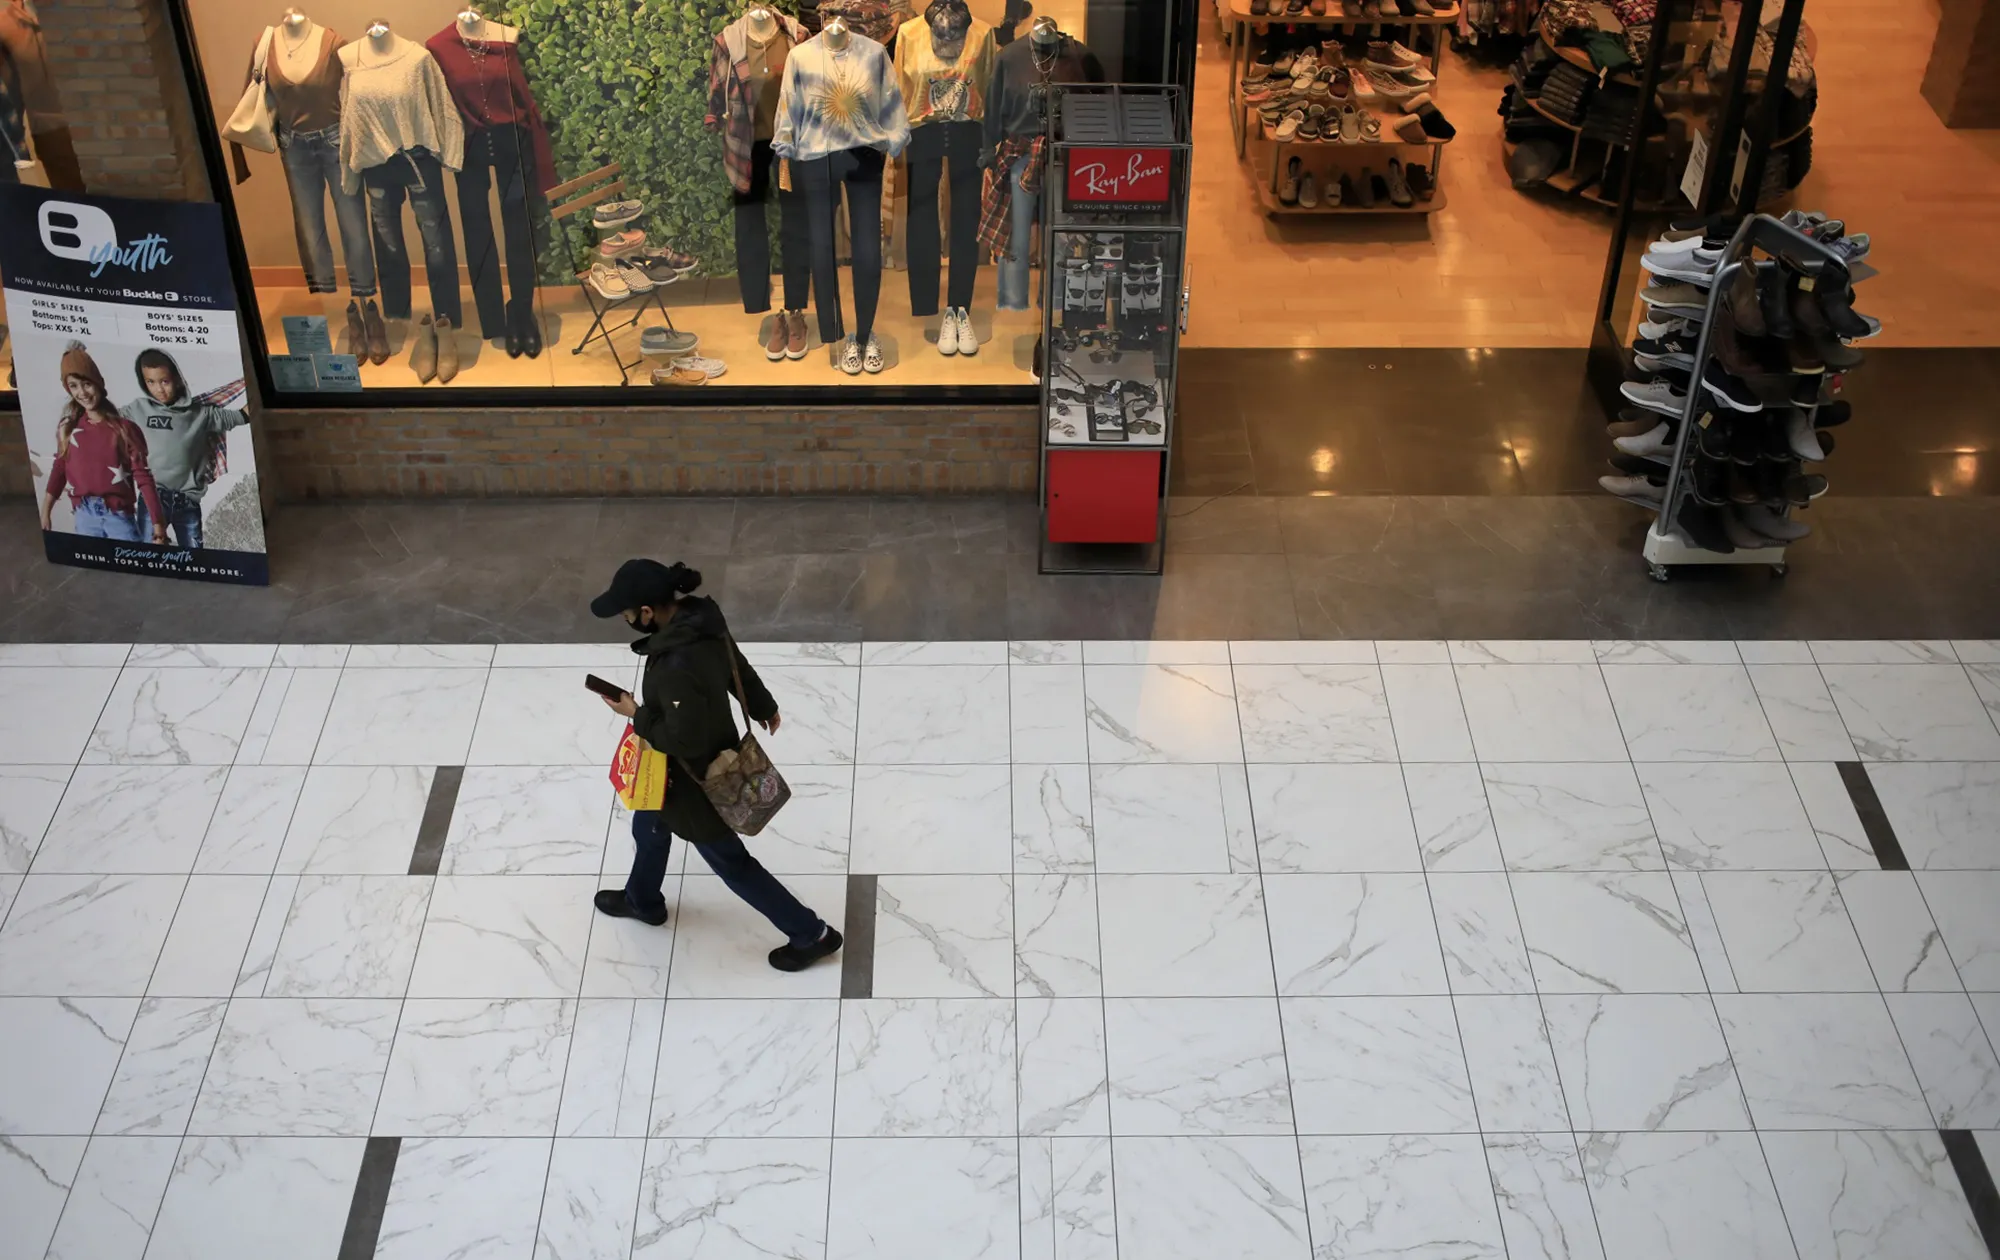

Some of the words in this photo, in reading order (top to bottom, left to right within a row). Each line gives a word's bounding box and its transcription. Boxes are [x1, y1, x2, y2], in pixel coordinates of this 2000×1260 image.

[1074, 153, 1163, 195] Ray-Ban
[1113, 203, 1139, 211] SINCE
[89, 233, 173, 278] youth
[14, 276, 34, 286] NOW
[36, 280, 81, 293] AVAILABLE
[97, 288, 121, 297] YOUR
[122, 288, 163, 300] Buckle
[182, 295, 216, 304] STORE.
[32, 299, 58, 309] GIRLS'
[61, 303, 85, 313] SIZES
[32, 309, 68, 322] Bottoms:
[70, 315, 88, 324] 5-16
[147, 312, 174, 321] BOYS'
[177, 314, 204, 323] SIZES
[32, 320, 53, 331] Tops:
[55, 323, 73, 333] XXS
[80, 327, 91, 335] XL
[145, 322, 185, 333] Bottoms:
[187, 326, 209, 334] 4-20
[149, 334, 173, 343] Tops:
[175, 336, 188, 344] XS
[196, 337, 208, 345] XL
[114, 546, 159, 559] Discover
[162, 550, 193, 564] youth
[185, 565, 206, 573] AND
[211, 567, 244, 577] MORE.
